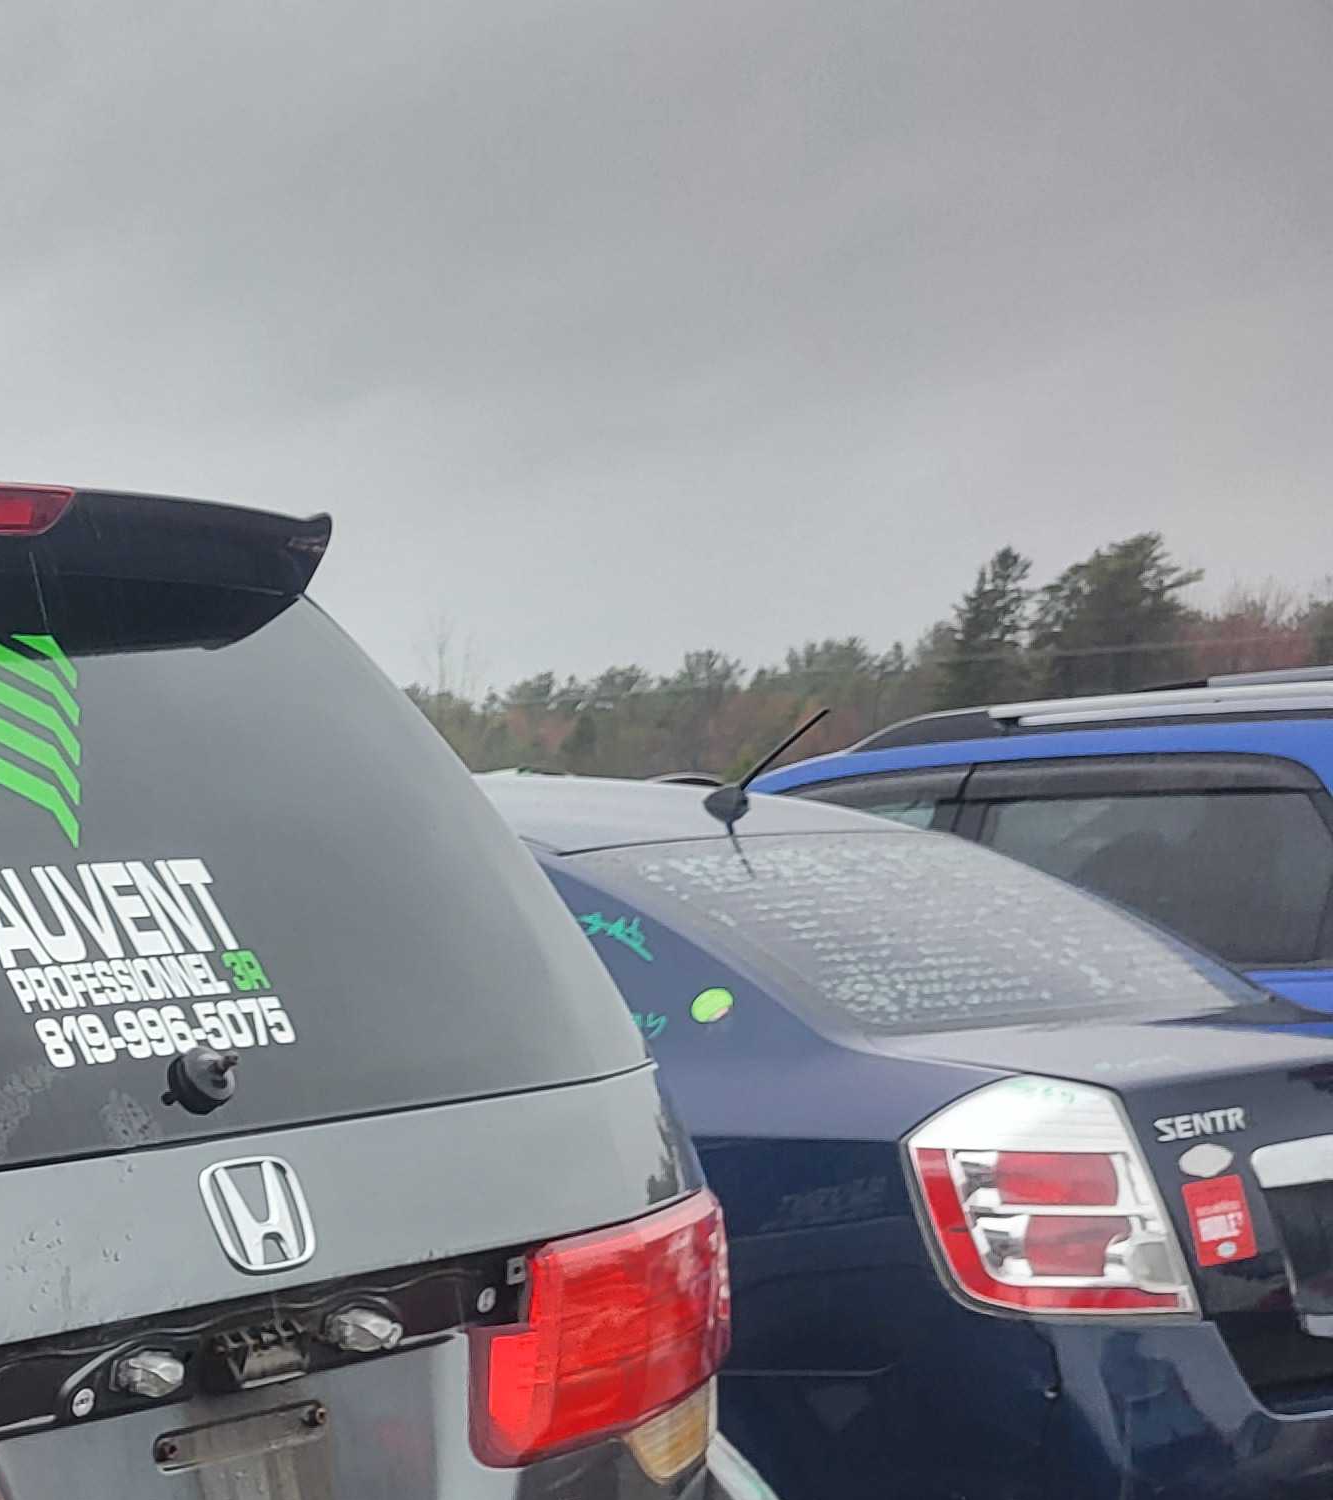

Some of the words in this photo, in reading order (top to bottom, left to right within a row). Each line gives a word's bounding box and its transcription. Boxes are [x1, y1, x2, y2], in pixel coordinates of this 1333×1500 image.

[6, 952, 232, 1013] PROFESSIONNEL
[221, 950, 272, 992] 3R
[34, 996, 296, 1068] 819-996-5075
[1153, 1106, 1246, 1143] SENTR
